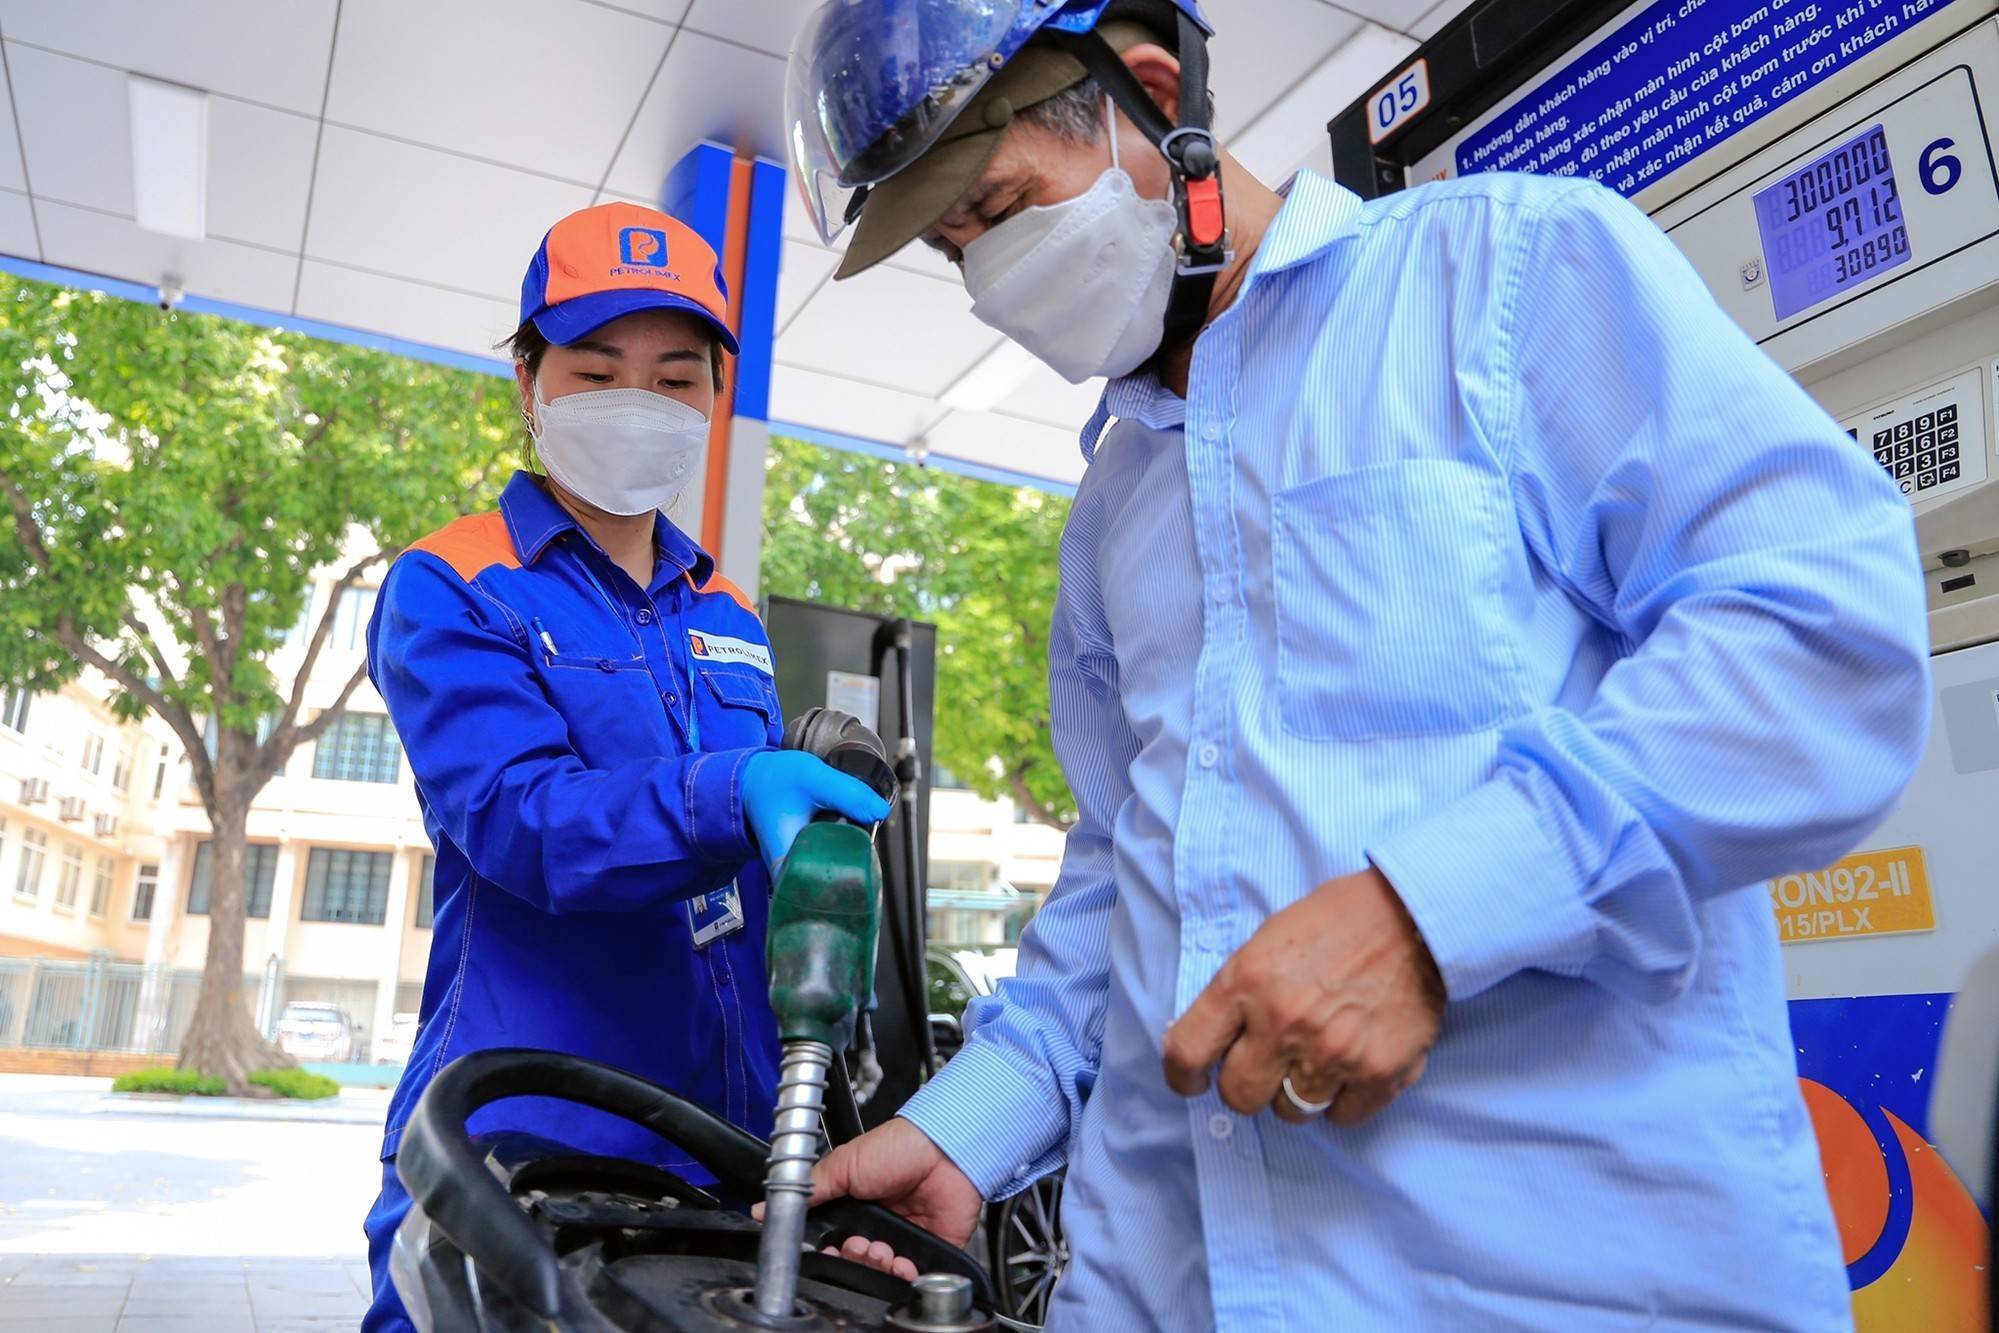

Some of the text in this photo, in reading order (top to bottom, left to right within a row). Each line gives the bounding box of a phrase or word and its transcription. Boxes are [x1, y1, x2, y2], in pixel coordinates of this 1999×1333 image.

[1378, 73, 1418, 128] 05
[1462, 158, 1472, 169] 1.
[1473, 129, 1513, 162] Hướng
[1539, 84, 1576, 116] khách
[1578, 60, 1611, 89] hàng
[1613, 41, 1638, 64] vào
[1640, 27, 1654, 44] vị
[1656, 14, 1676, 34] trí,
[1540, 138, 1571, 165] hàng
[1573, 121, 1596, 143] xác
[1598, 98, 1632, 126] nhận
[1634, 76, 1665, 102] màn
[1667, 51, 1700, 80] hình
[1703, 31, 1729, 56] cột
[1731, 7, 1768, 38] bơm
[1601, 126, 1630, 151] theo
[1633, 106, 1659, 133] yêu
[1661, 89, 1688, 111] cầu
[1691, 68, 1719, 92] của
[1721, 34, 1770, 73] khách
[1773, 4, 1822, 39] hàng.
[1606, 145, 1640, 174] nhận
[1643, 125, 1674, 151] màn
[1676, 101, 1710, 129] hình
[1713, 81, 1739, 106] cột
[1741, 58, 1779, 89] bơm
[1782, 24, 1832, 62] trước
[1835, 1, 1865, 30] khi
[1618, 174, 1635, 192] và
[1637, 158, 1663, 182] xác
[1665, 134, 1702, 164] nhận
[1705, 114, 1730, 140] kết
[1733, 94, 1768, 123] quả,
[1771, 70, 1807, 99] cám
[1811, 53, 1837, 75] ơn
[1840, 14, 1899, 58] khách
[1498, 116, 1570, 168] khách hàng.
[1918, 137, 1962, 196] 6
[1784, 131, 1889, 222] 300000
[1834, 225, 1908, 284] 30890
[1877, 410, 1953, 446] 7 8 9 F1
[1878, 428, 1955, 464] 4 5 6 F2
[1900, 447, 1956, 476] 2 3 F3
[1900, 480, 1911, 494] C
[1942, 466, 1957, 478] F4
[708, 645, 769, 665] PETROLIMEX
[1778, 906, 1873, 937] 15/PLX
